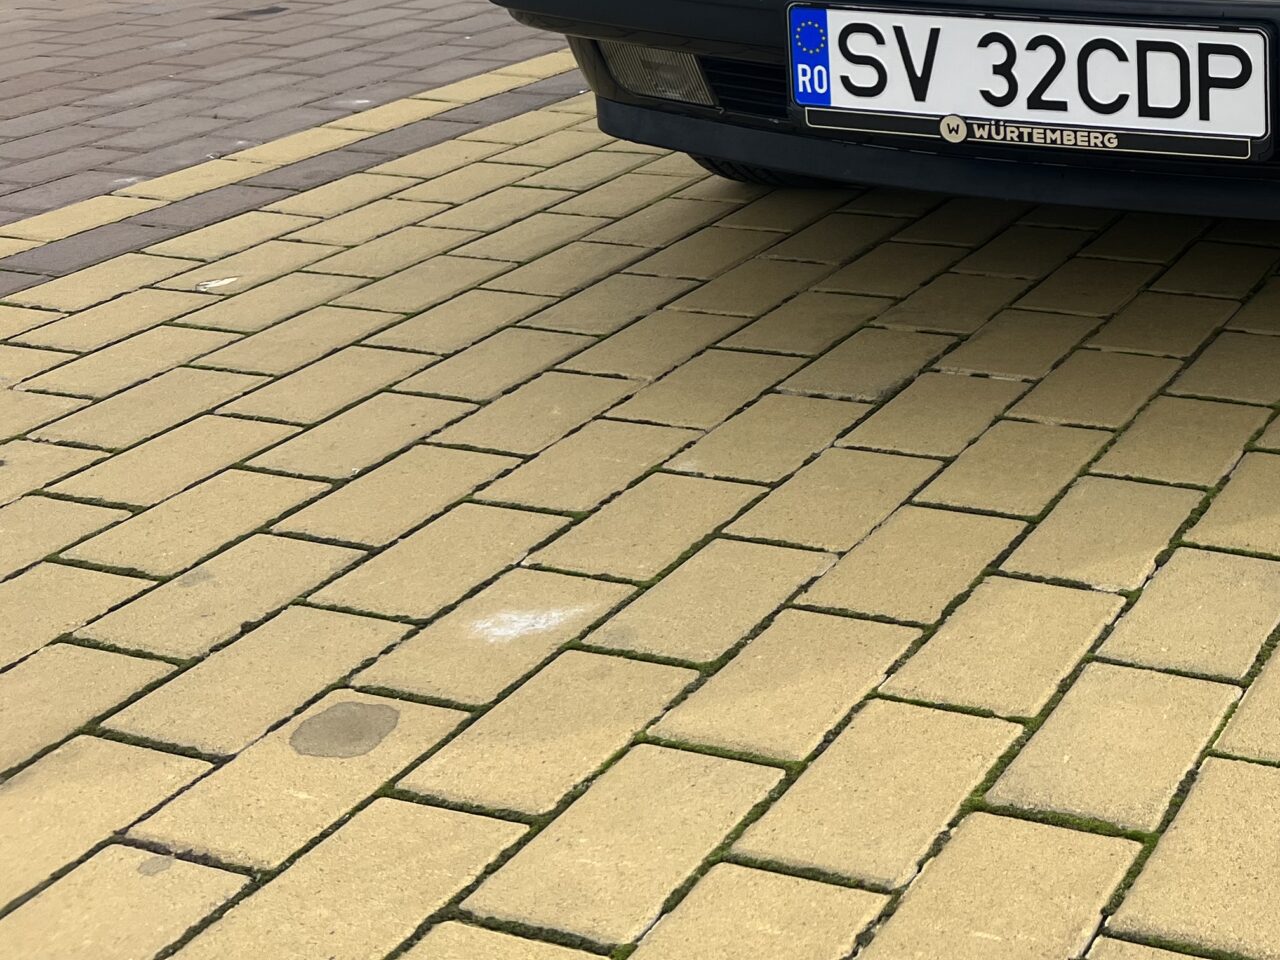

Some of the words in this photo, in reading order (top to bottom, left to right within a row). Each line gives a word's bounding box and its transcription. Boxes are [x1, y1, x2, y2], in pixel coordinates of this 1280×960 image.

[797, 63, 828, 94] RO
[838, 22, 941, 103] SV
[977, 31, 1253, 121] 32CDP
[946, 122, 960, 136] W
[972, 119, 1119, 148] WÜRTEMBERG
